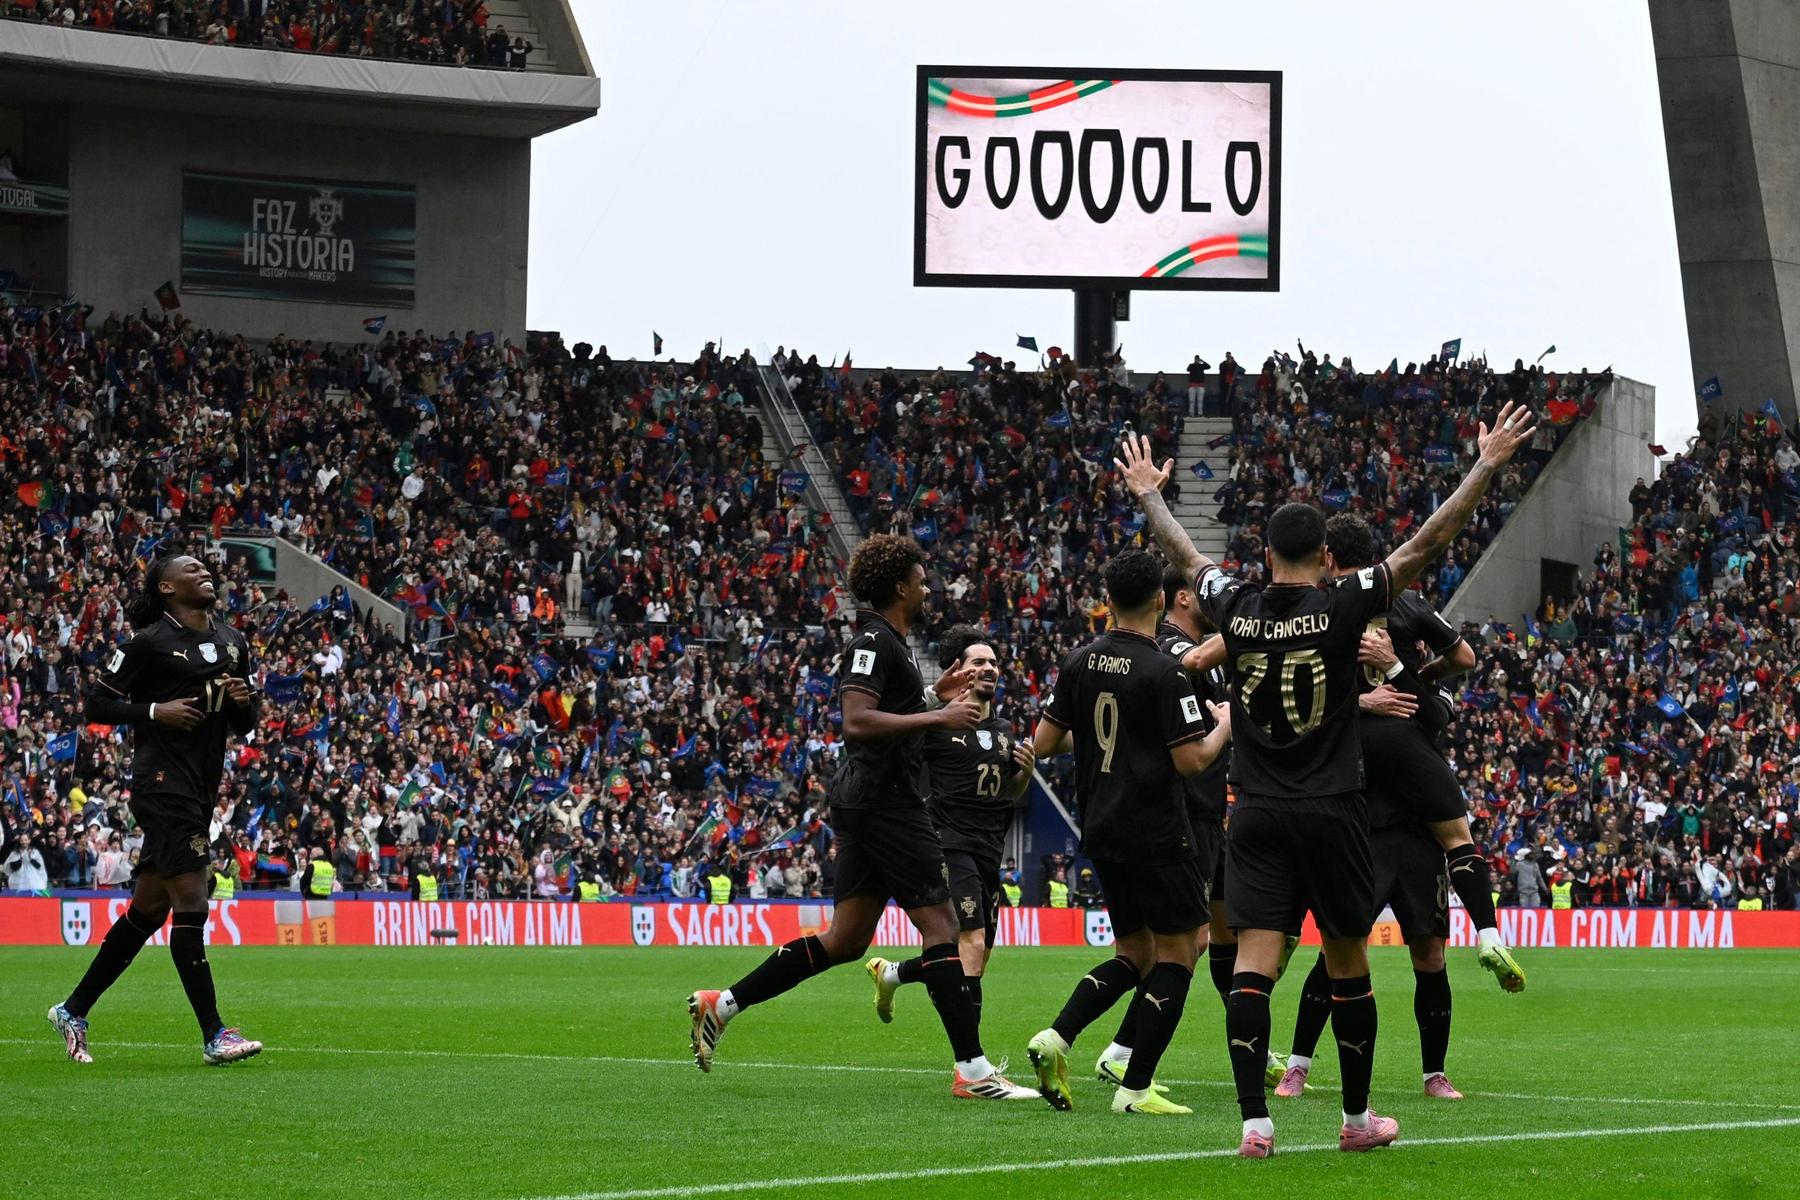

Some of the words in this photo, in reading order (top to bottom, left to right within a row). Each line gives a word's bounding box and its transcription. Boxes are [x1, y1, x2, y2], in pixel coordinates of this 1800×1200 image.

[935, 128, 1262, 224] GOOOOLO
[0, 187, 39, 208] TUGAL
[253, 198, 297, 234] FAZ
[243, 228, 355, 272] HISTÓRIA
[1264, 612, 1329, 640] CANCELO
[1087, 652, 1096, 672] G.
[1097, 655, 1132, 676] RAMOS
[205, 679, 229, 713] 17
[1236, 649, 1327, 737] 20
[1094, 691, 1119, 774] 9
[975, 762, 1001, 798] 23
[108, 898, 240, 946] SES
[466, 902, 515, 946] COM
[667, 903, 774, 946] SAGRES
[1570, 909, 1638, 947] COM
